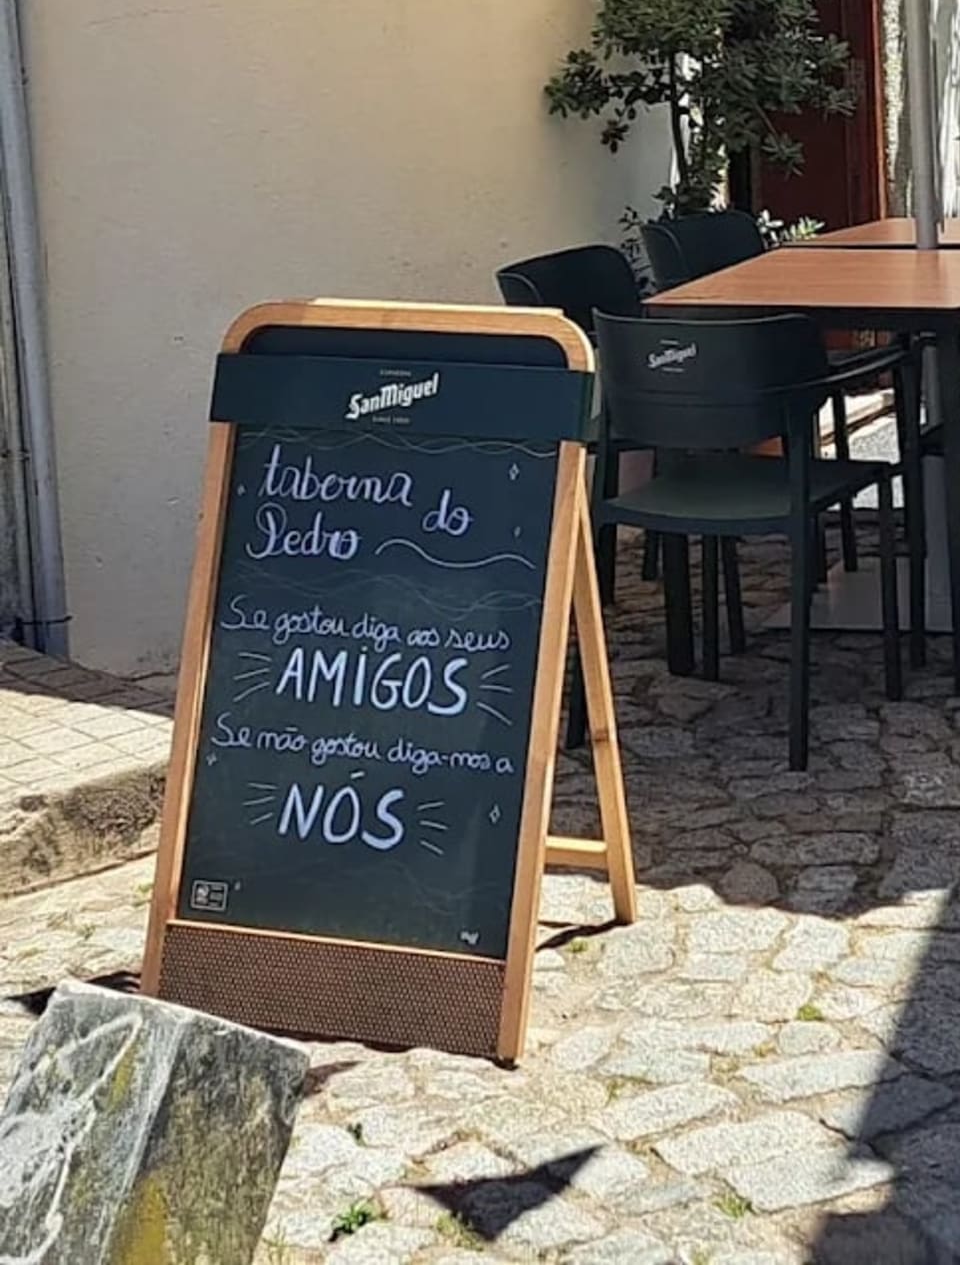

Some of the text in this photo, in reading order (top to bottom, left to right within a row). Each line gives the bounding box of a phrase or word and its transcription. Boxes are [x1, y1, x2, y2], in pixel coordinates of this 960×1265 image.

[246, 502, 362, 559] Pedro
[422, 489, 474, 536] do
[220, 594, 510, 652] Se gostou diga aos seus
[211, 712, 251, 747] Se
[311, 732, 381, 765] gostou
[495, 756, 514, 774] a
[278, 770, 404, 851] NÓS
